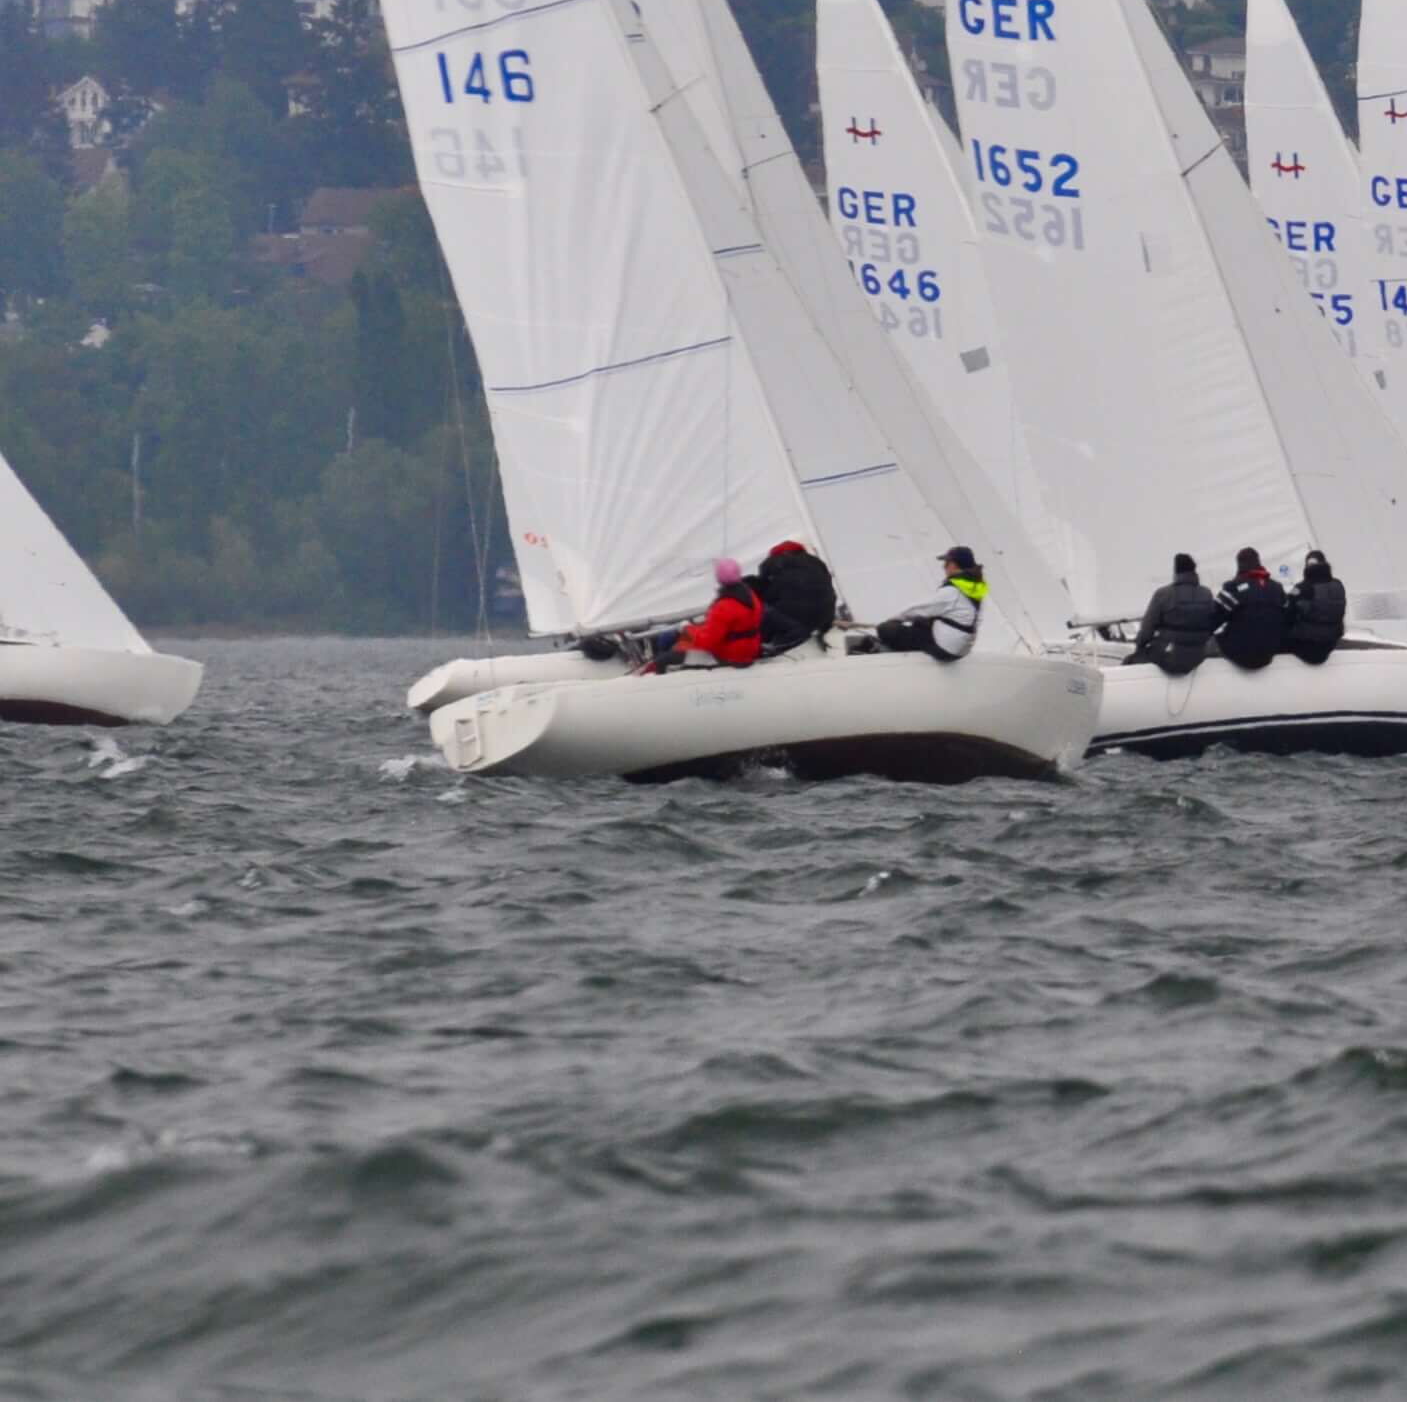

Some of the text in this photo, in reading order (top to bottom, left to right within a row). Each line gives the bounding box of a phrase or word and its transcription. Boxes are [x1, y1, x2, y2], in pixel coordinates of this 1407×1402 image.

[436, 48, 535, 104] 146
[972, 139, 1081, 199] 1652
[838, 186, 918, 228] GER
[860, 262, 942, 303] 646
[1309, 292, 1354, 326] 5
